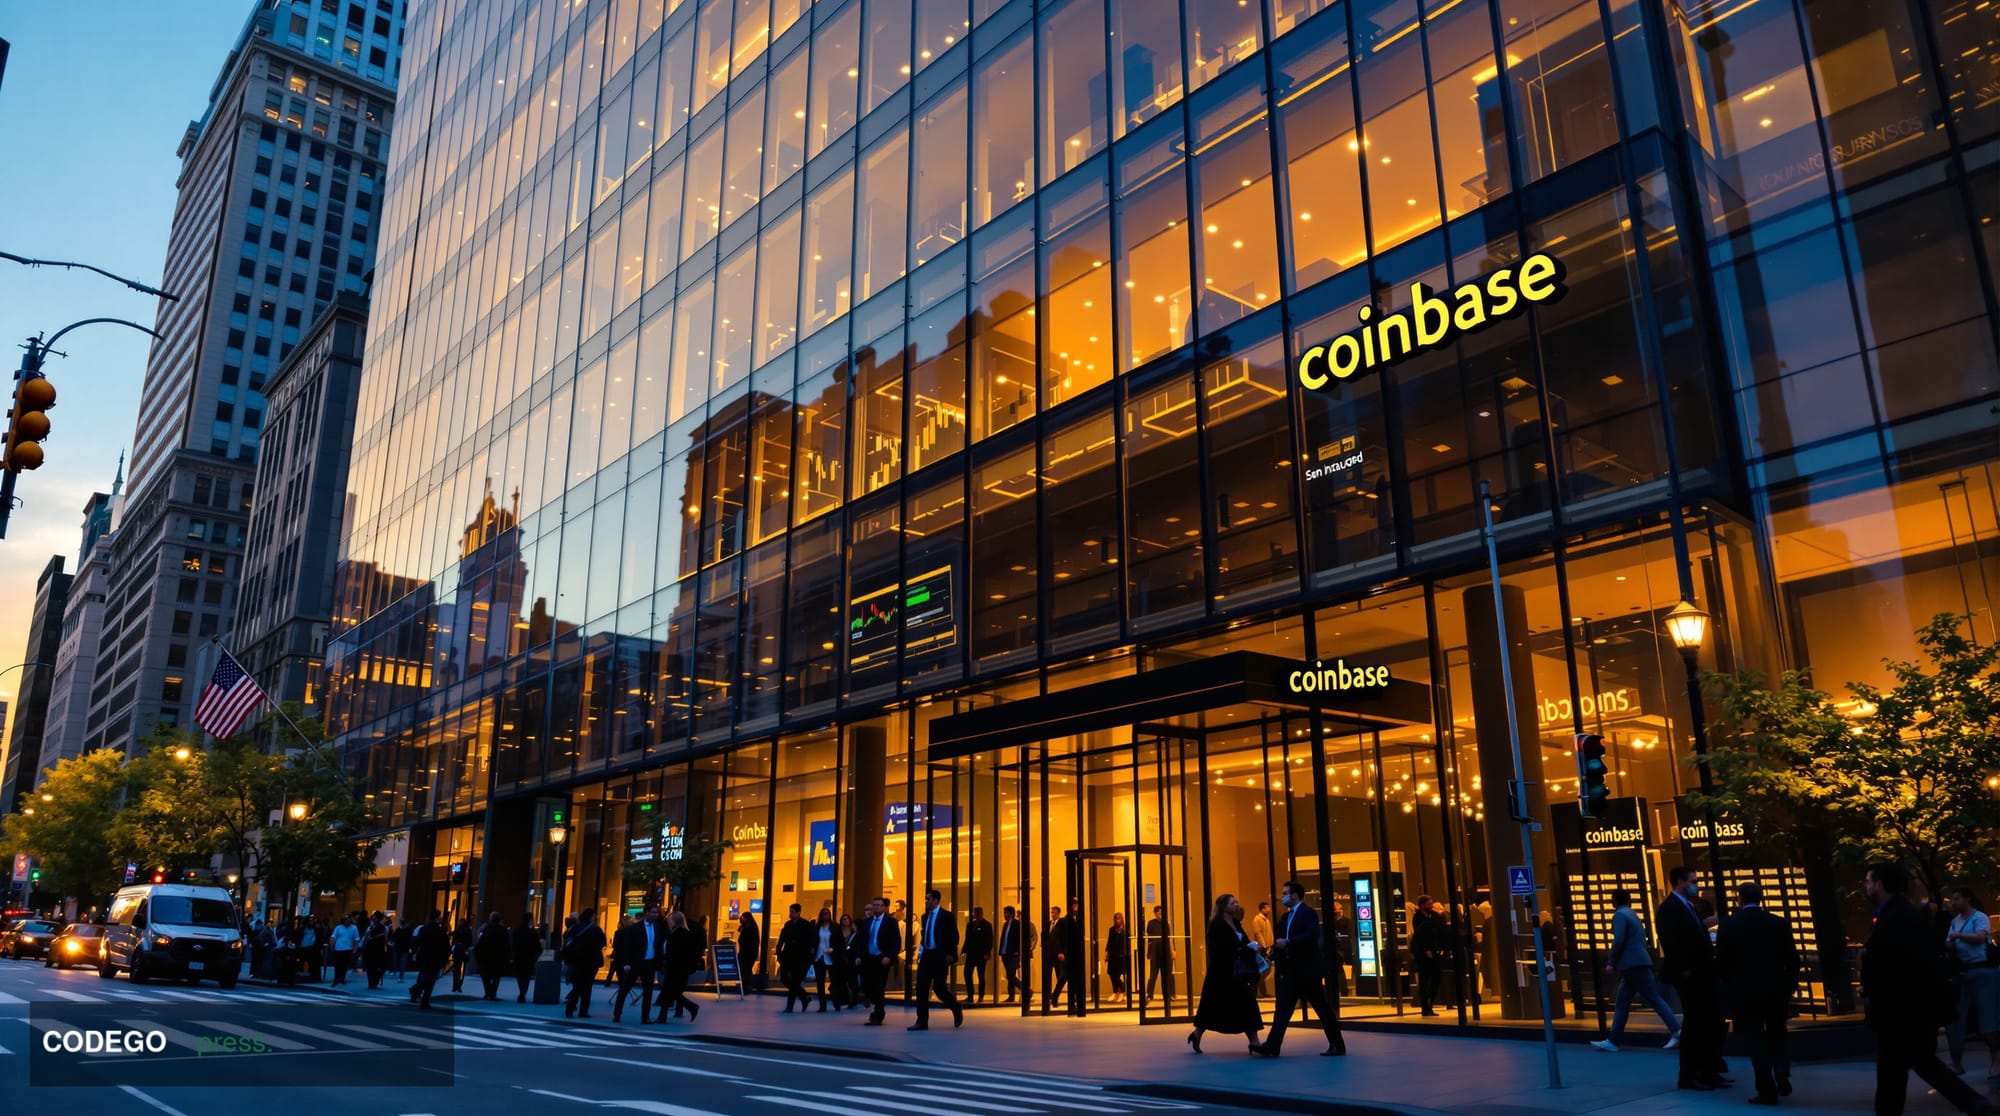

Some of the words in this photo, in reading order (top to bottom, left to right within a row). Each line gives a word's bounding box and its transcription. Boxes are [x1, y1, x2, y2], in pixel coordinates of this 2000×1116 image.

[1299, 254, 1556, 391] coinbase
[1289, 659, 1389, 693] coinbase
[733, 822, 768, 841] Coinba
[1585, 826, 1644, 844] coinbase
